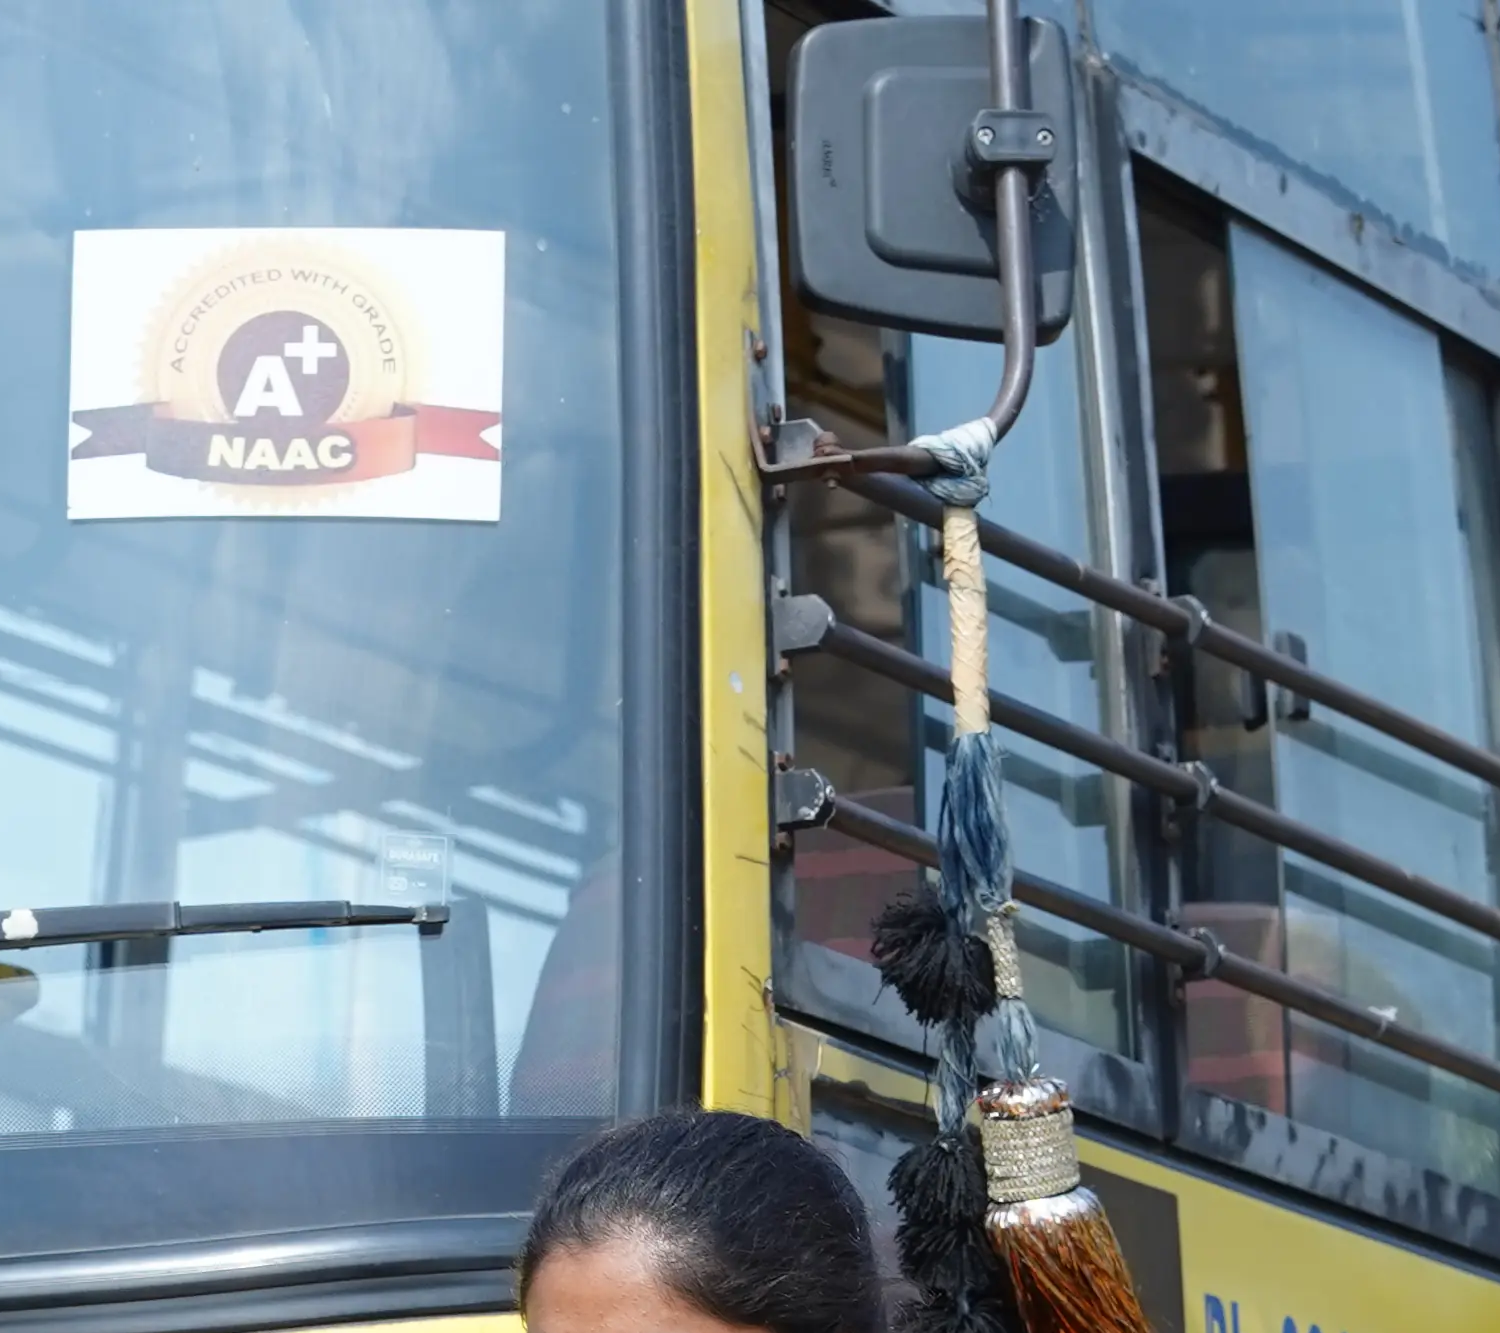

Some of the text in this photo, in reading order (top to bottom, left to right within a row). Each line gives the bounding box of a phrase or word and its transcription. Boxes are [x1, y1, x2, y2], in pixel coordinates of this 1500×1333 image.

[169, 268, 397, 374] ACCREDITED WITH GRADE
[208, 435, 353, 471] NAAC
